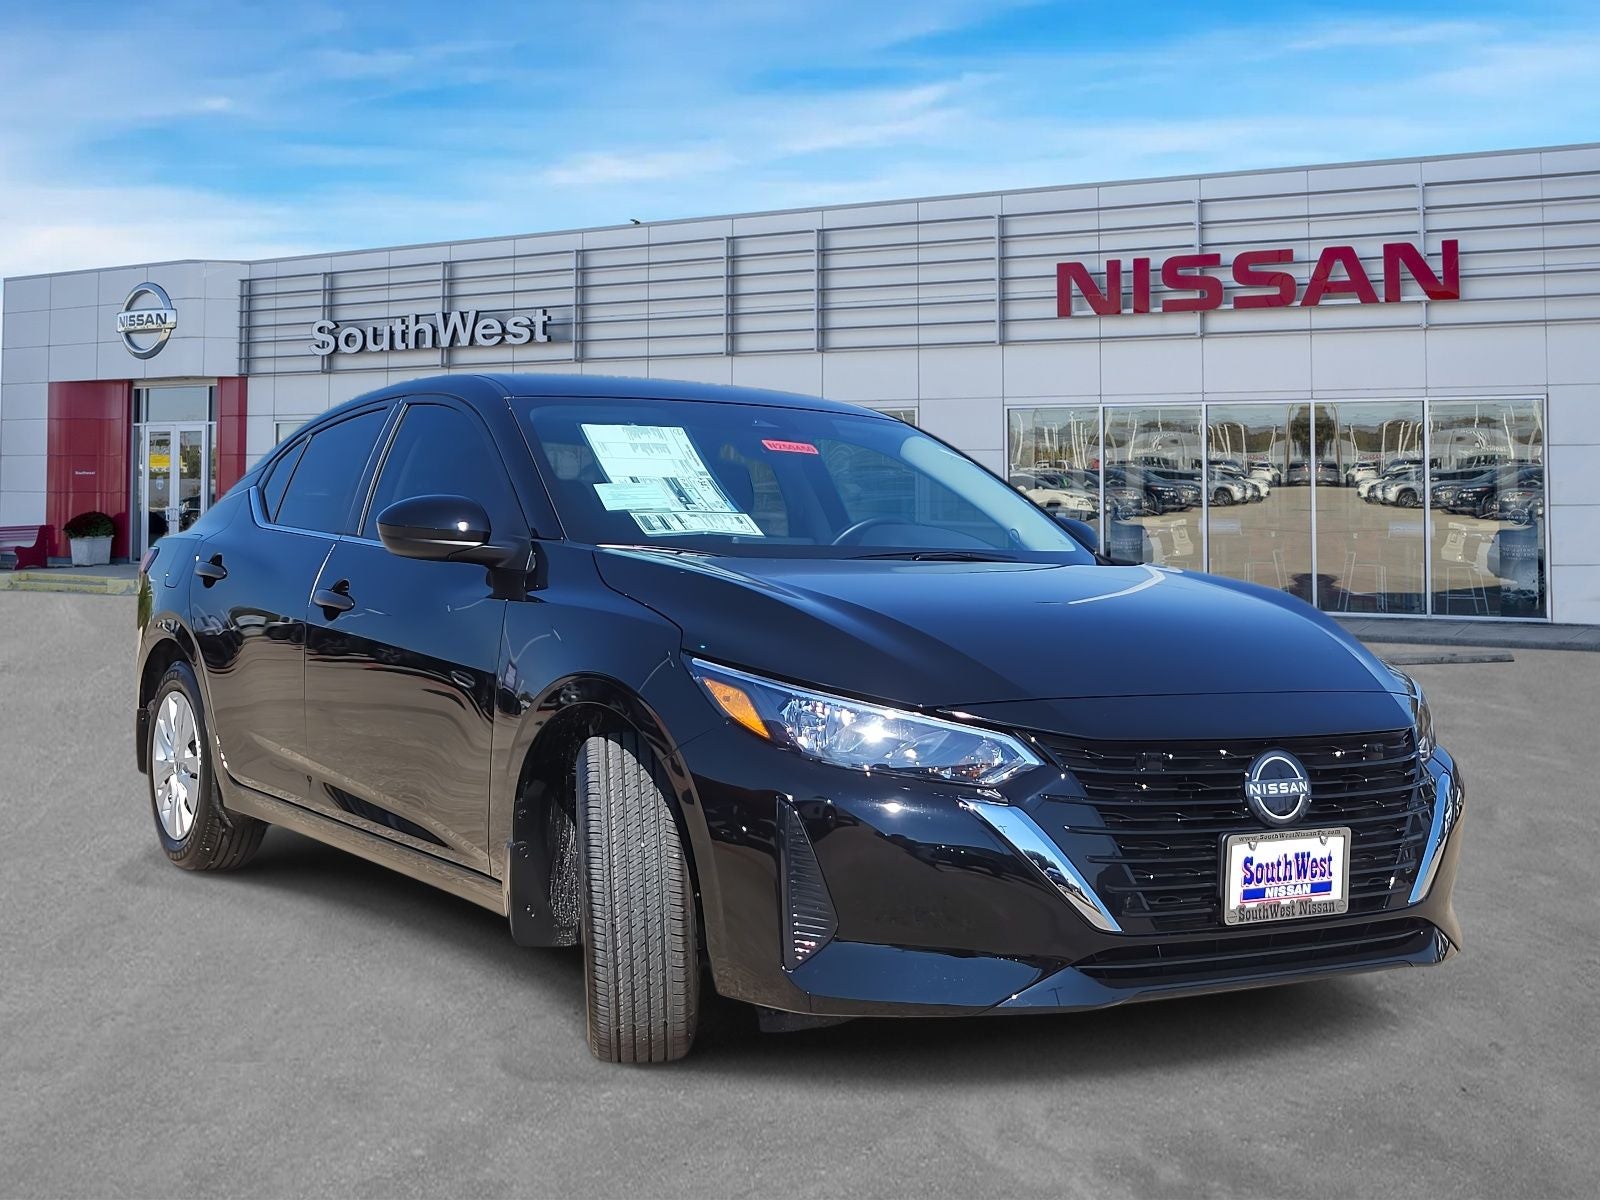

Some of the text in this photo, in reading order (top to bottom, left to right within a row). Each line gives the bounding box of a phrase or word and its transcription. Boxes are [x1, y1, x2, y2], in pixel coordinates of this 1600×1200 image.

[1056, 239, 1460, 318] NISSAN
[118, 311, 169, 328] NISSAN
[308, 308, 552, 357] SouthWest
[1249, 781, 1308, 795] NISSAN
[1241, 850, 1333, 886] SouthWest
[1264, 884, 1312, 898] NISSAN
[1238, 900, 1336, 922] SouthWest Nissan
